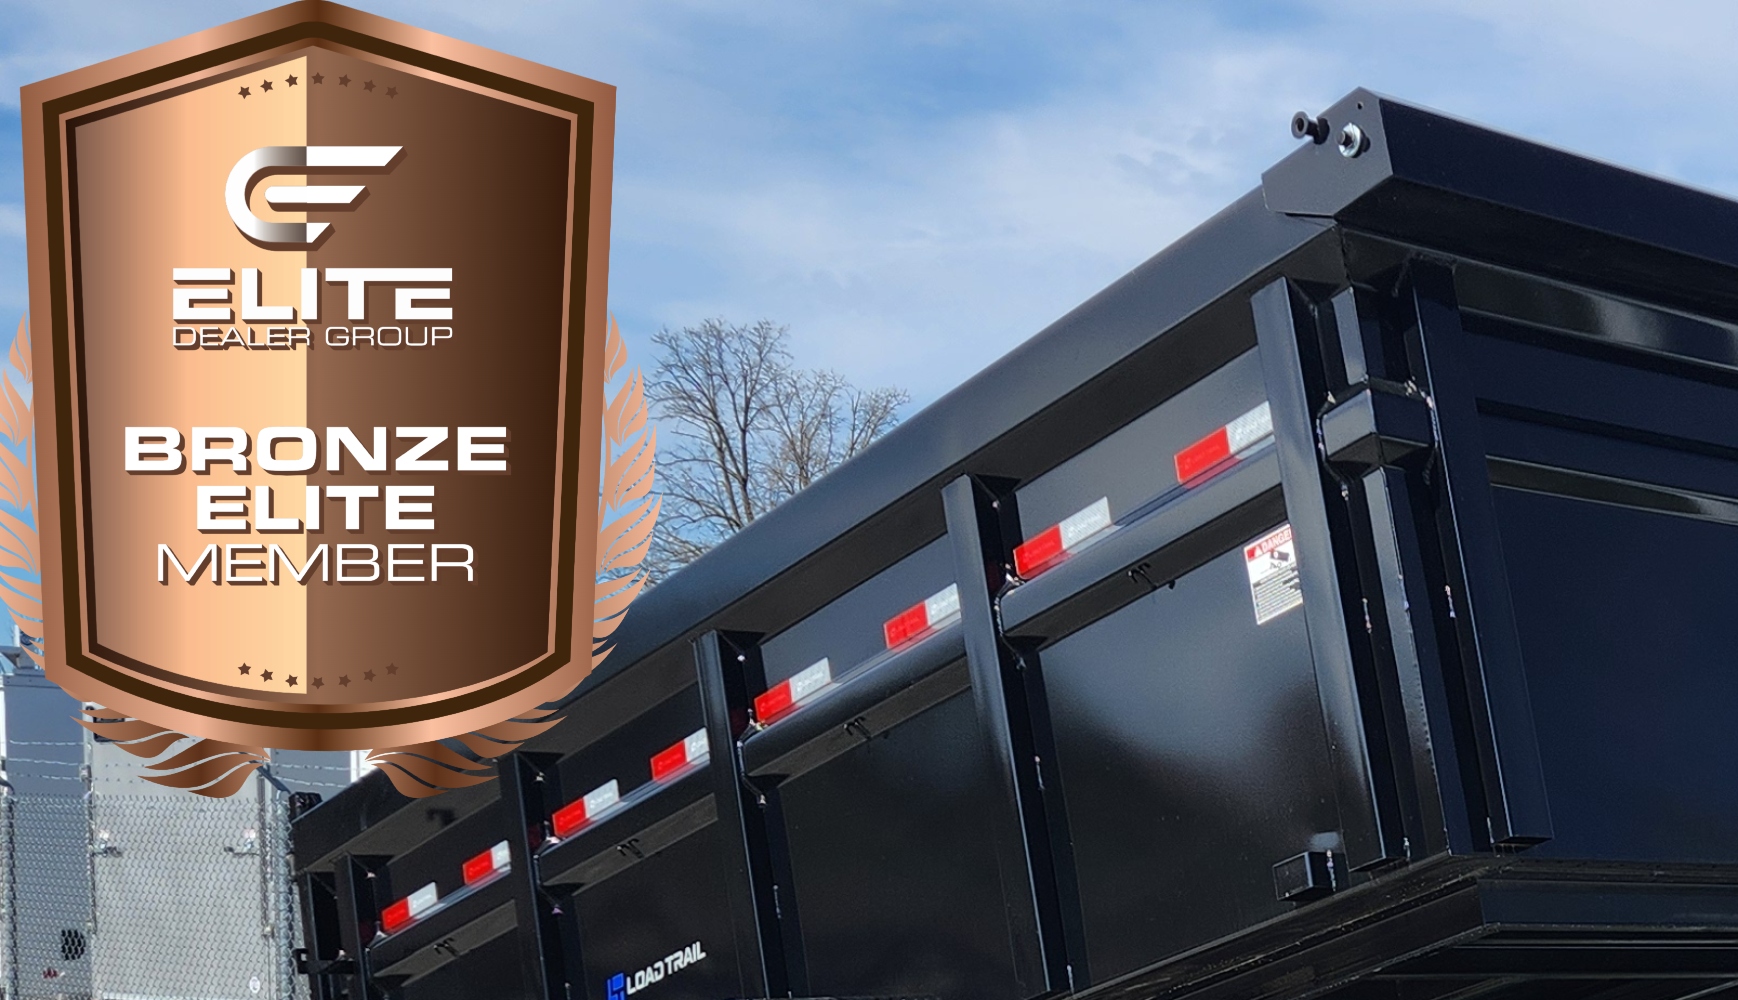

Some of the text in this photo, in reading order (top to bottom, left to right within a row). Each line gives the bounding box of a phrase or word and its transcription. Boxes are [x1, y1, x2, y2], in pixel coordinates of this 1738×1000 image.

[1260, 526, 1292, 554] DANGE
[626, 961, 665, 996] LOAD
[664, 940, 707, 975] TRAIL
